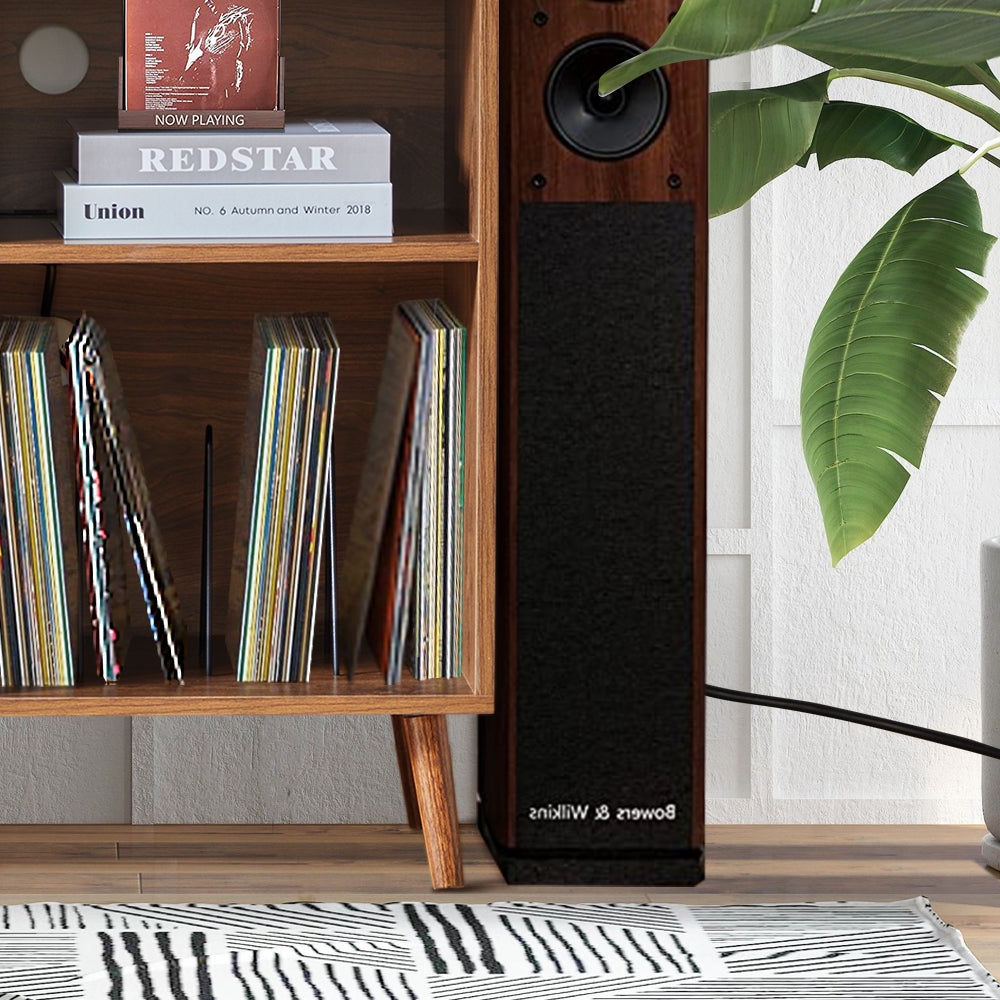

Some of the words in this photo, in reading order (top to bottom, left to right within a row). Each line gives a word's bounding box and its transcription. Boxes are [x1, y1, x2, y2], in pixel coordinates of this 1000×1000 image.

[155, 114, 189, 126] NOW
[192, 114, 245, 126] PLAYING
[138, 146, 338, 172] REDSTAR
[84, 203, 145, 220] Union
[194, 206, 214, 216] NO.
[219, 206, 226, 216] 6
[231, 205, 275, 216] Autumn
[276, 204, 299, 215] and
[304, 204, 340, 215] Winter
[346, 204, 372, 215] 2018
